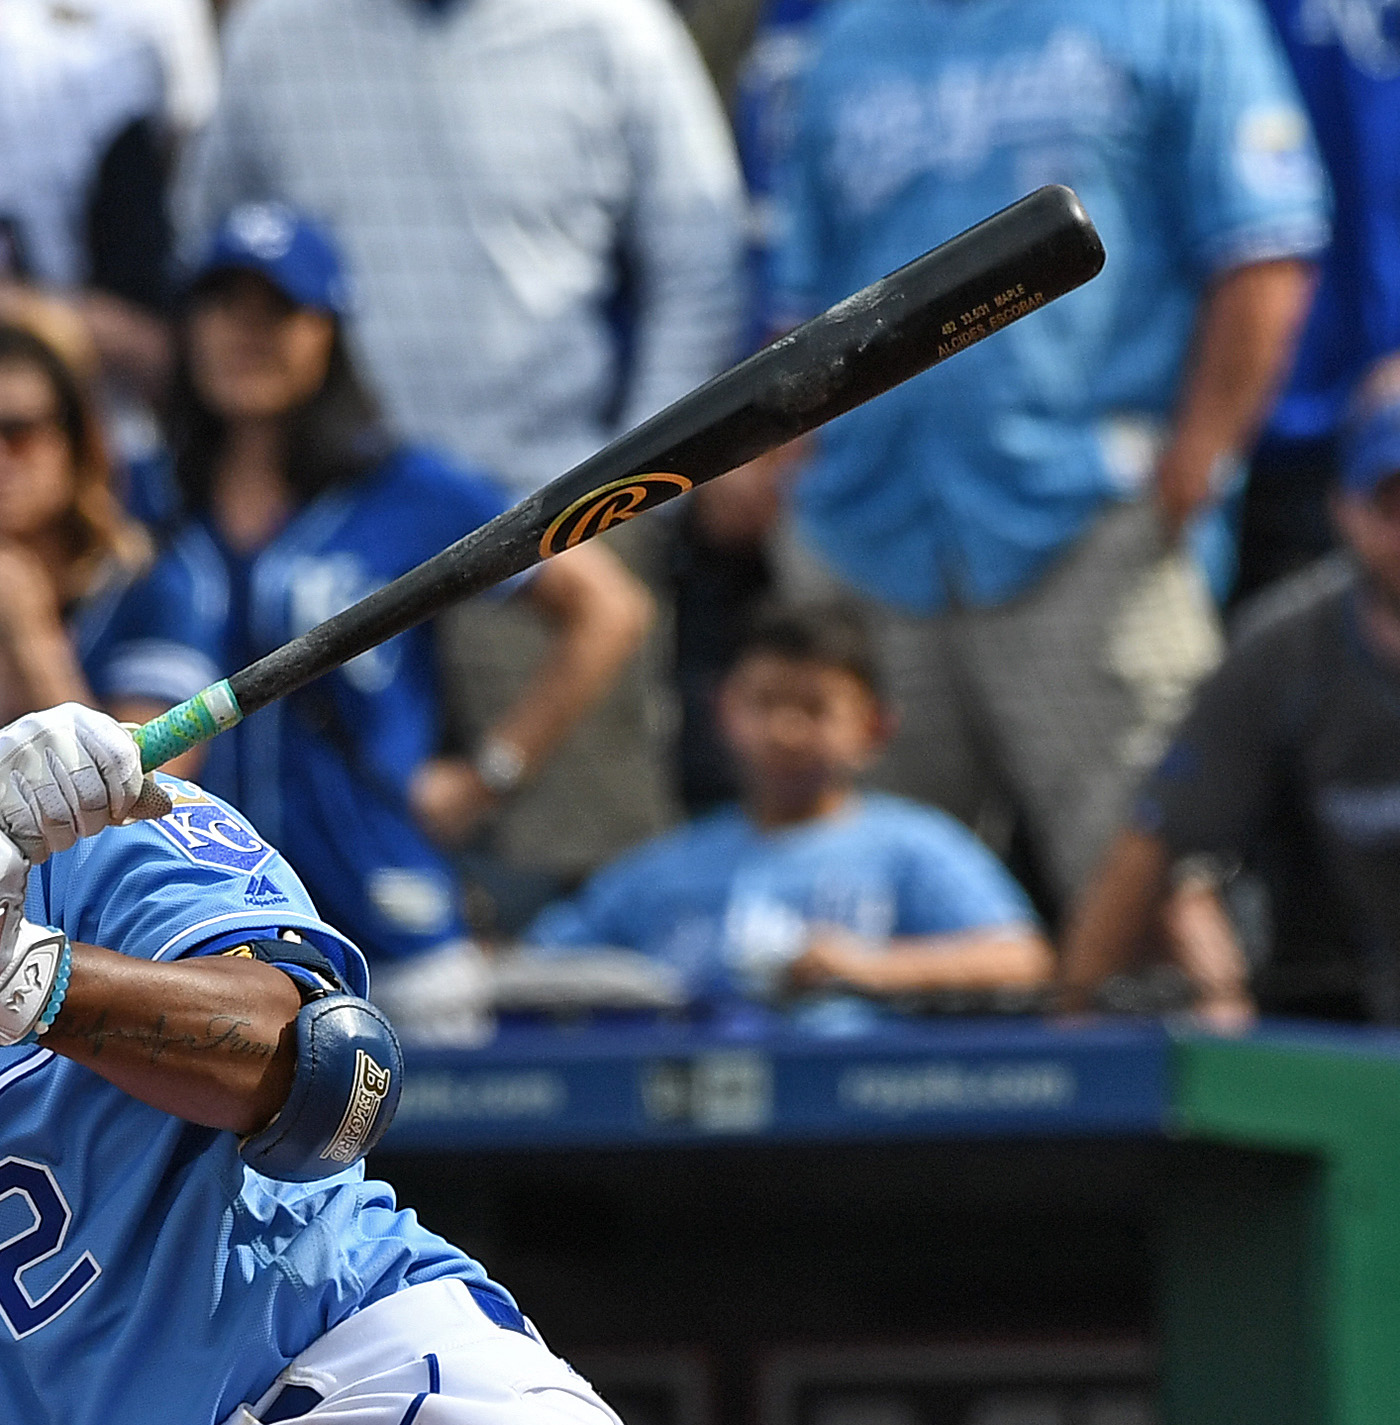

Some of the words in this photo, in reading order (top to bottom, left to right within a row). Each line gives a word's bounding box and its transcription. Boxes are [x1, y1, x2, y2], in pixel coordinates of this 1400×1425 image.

[993, 283, 1026, 308] MAPLE
[937, 323, 986, 358] ALCIDES
[988, 292, 1045, 329] ESCOBAR
[162, 811, 263, 854] KC
